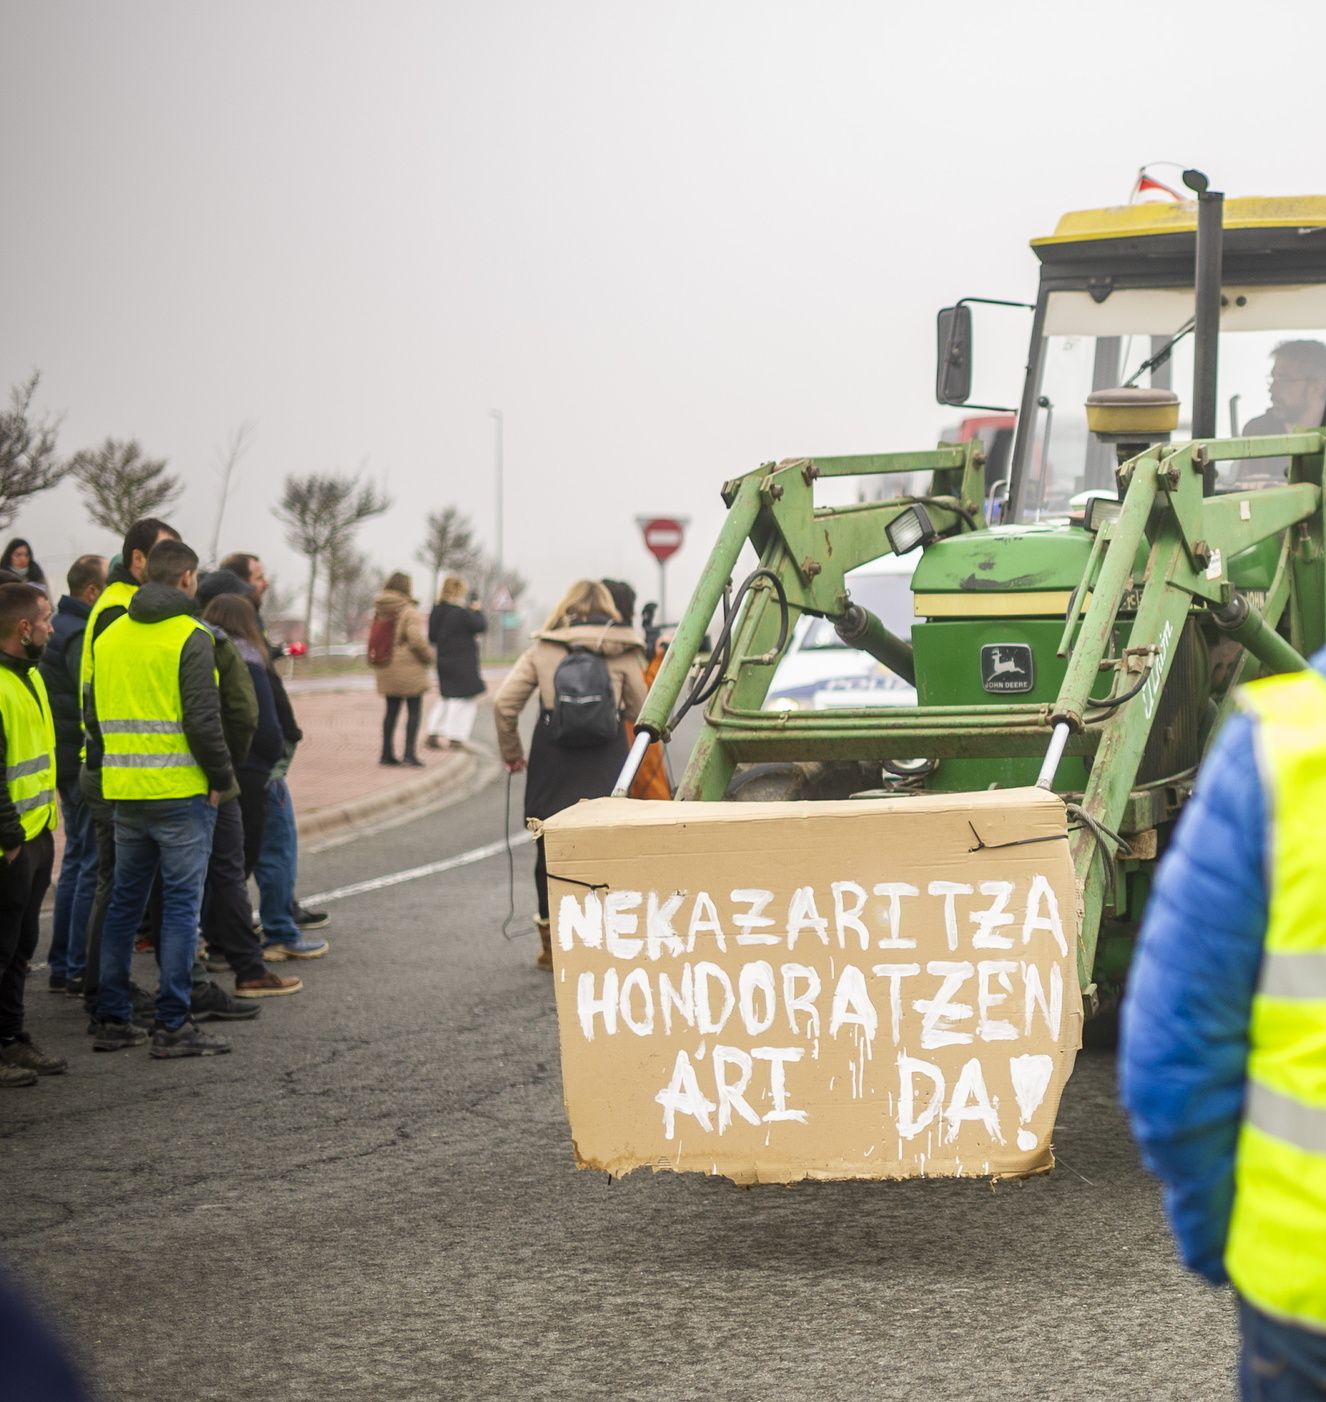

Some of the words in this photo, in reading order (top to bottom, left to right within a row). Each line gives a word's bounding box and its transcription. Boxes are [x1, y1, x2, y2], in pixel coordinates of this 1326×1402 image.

[985, 681, 1004, 689] JOHN
[1005, 681, 1028, 689] DEERE
[557, 875, 1068, 960] NEKAZARITZA
[576, 960, 1063, 1049] HONDORATZEN
[655, 1045, 808, 1140] ARI
[895, 1050, 1054, 1151] DA!
